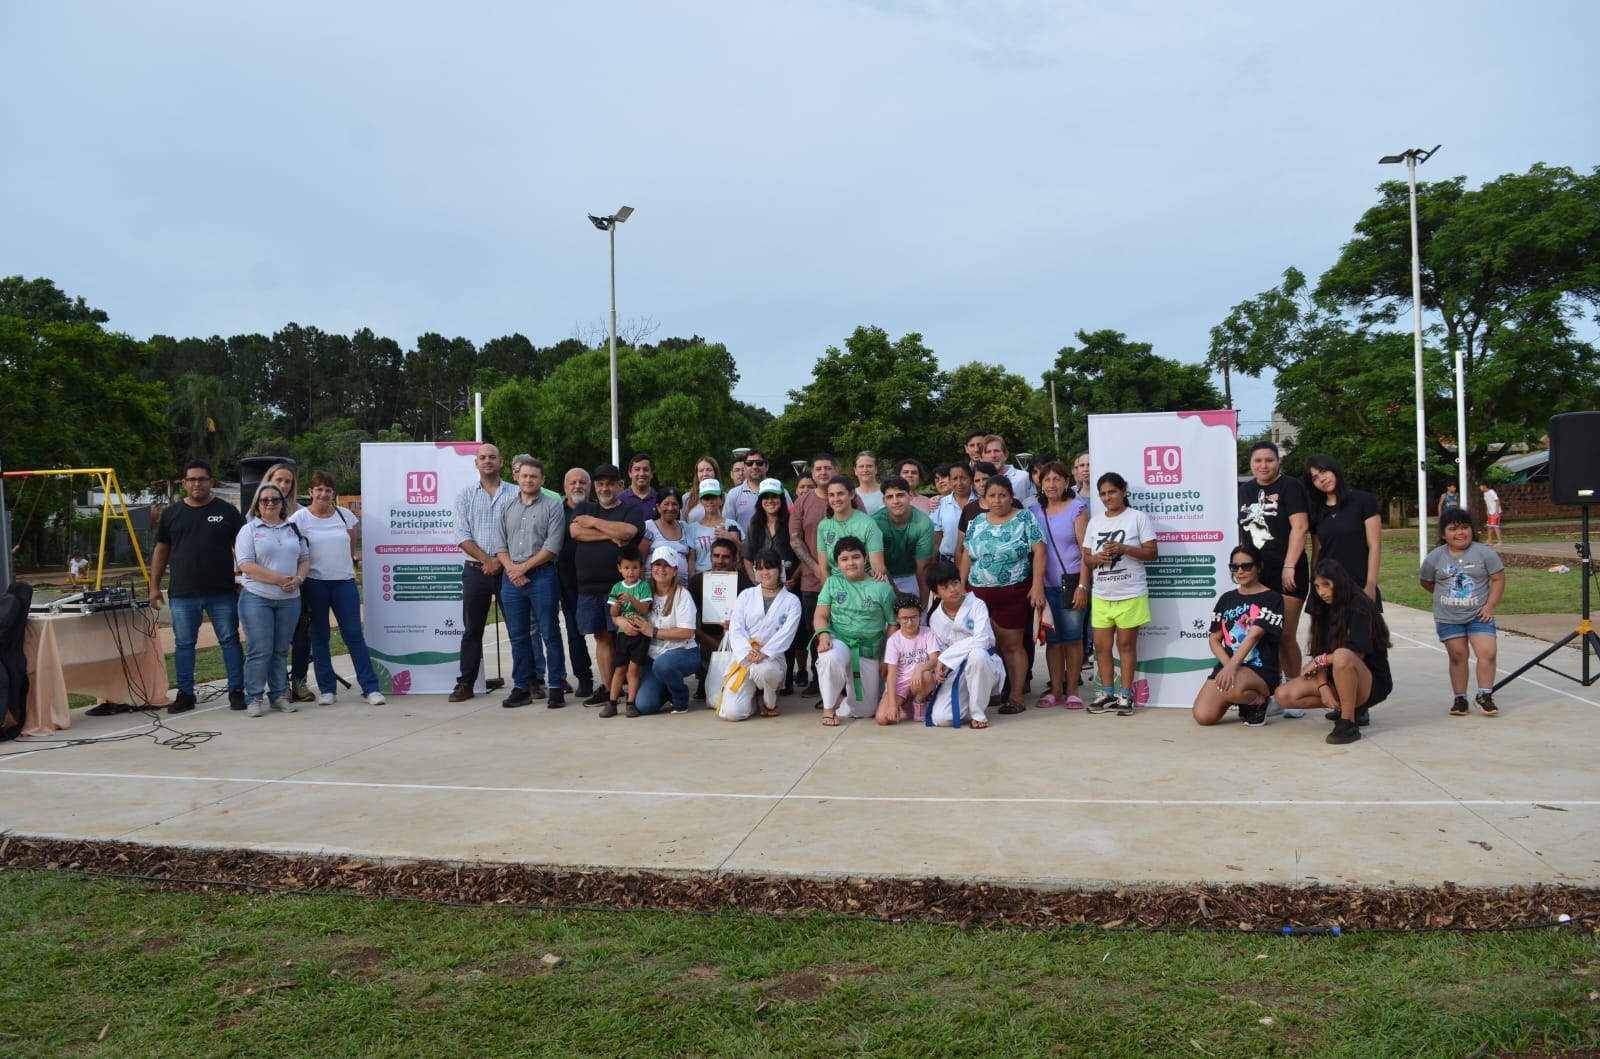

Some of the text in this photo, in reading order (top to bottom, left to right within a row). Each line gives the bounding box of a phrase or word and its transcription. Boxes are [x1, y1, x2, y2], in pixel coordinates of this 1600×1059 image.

[1147, 448, 1179, 471] 10
[408, 473, 436, 493] 10
[1148, 472, 1179, 484] años
[409, 493, 435, 503] años
[390, 509, 452, 518] Presupuesto
[1130, 502, 1204, 514] articipativo
[390, 519, 454, 529] Participativo
[1157, 533, 1179, 541] señar
[1191, 532, 1219, 541] ciudad
[1440, 595, 1479, 607] FORTNITE
